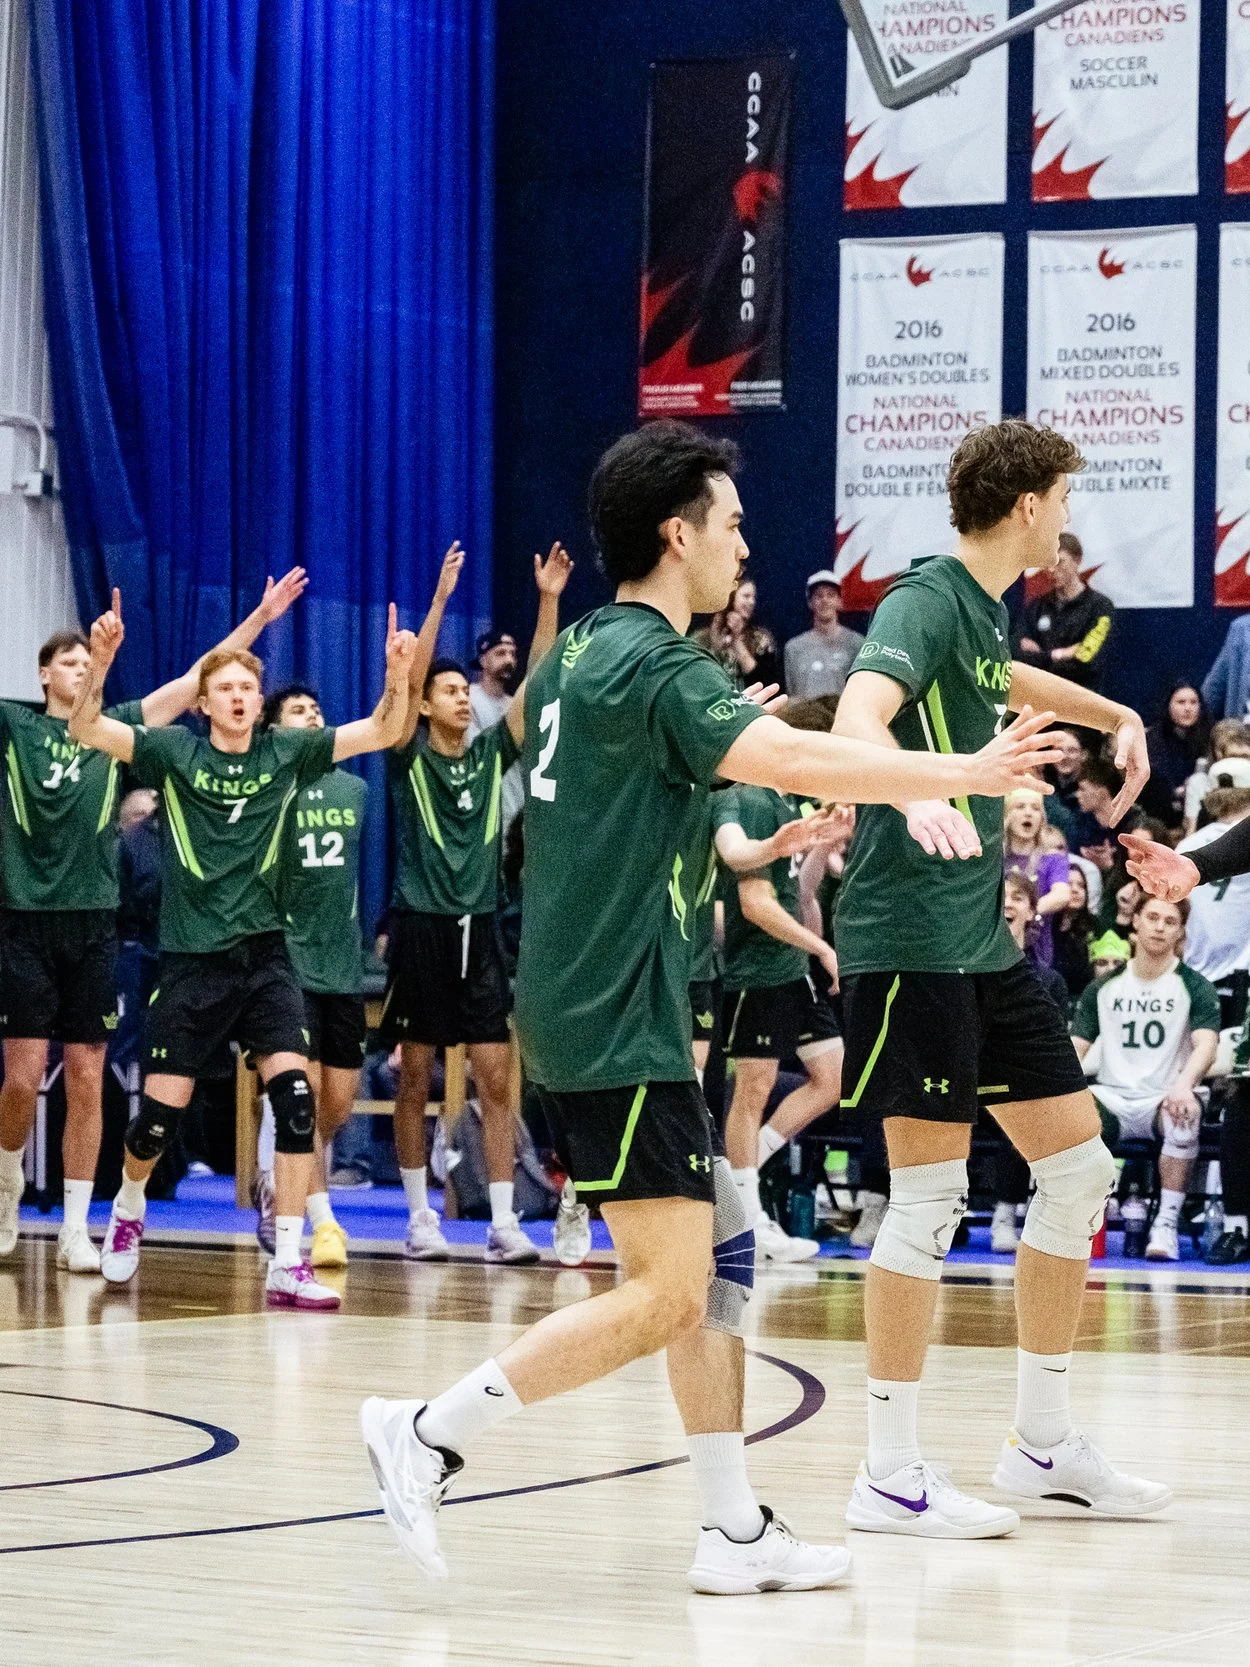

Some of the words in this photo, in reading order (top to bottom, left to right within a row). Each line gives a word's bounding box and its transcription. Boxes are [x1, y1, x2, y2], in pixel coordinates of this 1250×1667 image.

[882, 0, 967, 15] NATIONAL
[1064, 28, 1164, 47] CANADIENS
[1080, 55, 1148, 72] SOCCER
[1069, 72, 1158, 90] MASCULIN
[745, 71, 762, 163] CCAA
[740, 230, 755, 323] ACSC
[894, 320, 942, 339] 2016
[1087, 313, 1136, 332] 2016
[866, 352, 968, 368] BADMINTON
[1057, 345, 1163, 363] BADMINTON
[920, 368, 991, 384] DOUBLES
[1039, 365, 1096, 381] MIXED
[1100, 361, 1180, 378] DOUBLES
[873, 395, 958, 409] NATIONAL
[1065, 389, 1152, 405] NATIONAL
[845, 411, 988, 433] CHAMPIONS
[1037, 405, 1184, 429] CHAMPIONS
[844, 481, 911, 498] DOUBLE
[1119, 475, 1171, 490] MIXTE
[530, 699, 560, 802] 2
[223, 798, 248, 824] 7
[296, 808, 356, 828] INGS
[298, 831, 344, 868] 12
[1112, 998, 1175, 1014] KINGS
[1121, 1020, 1166, 1049] 10
